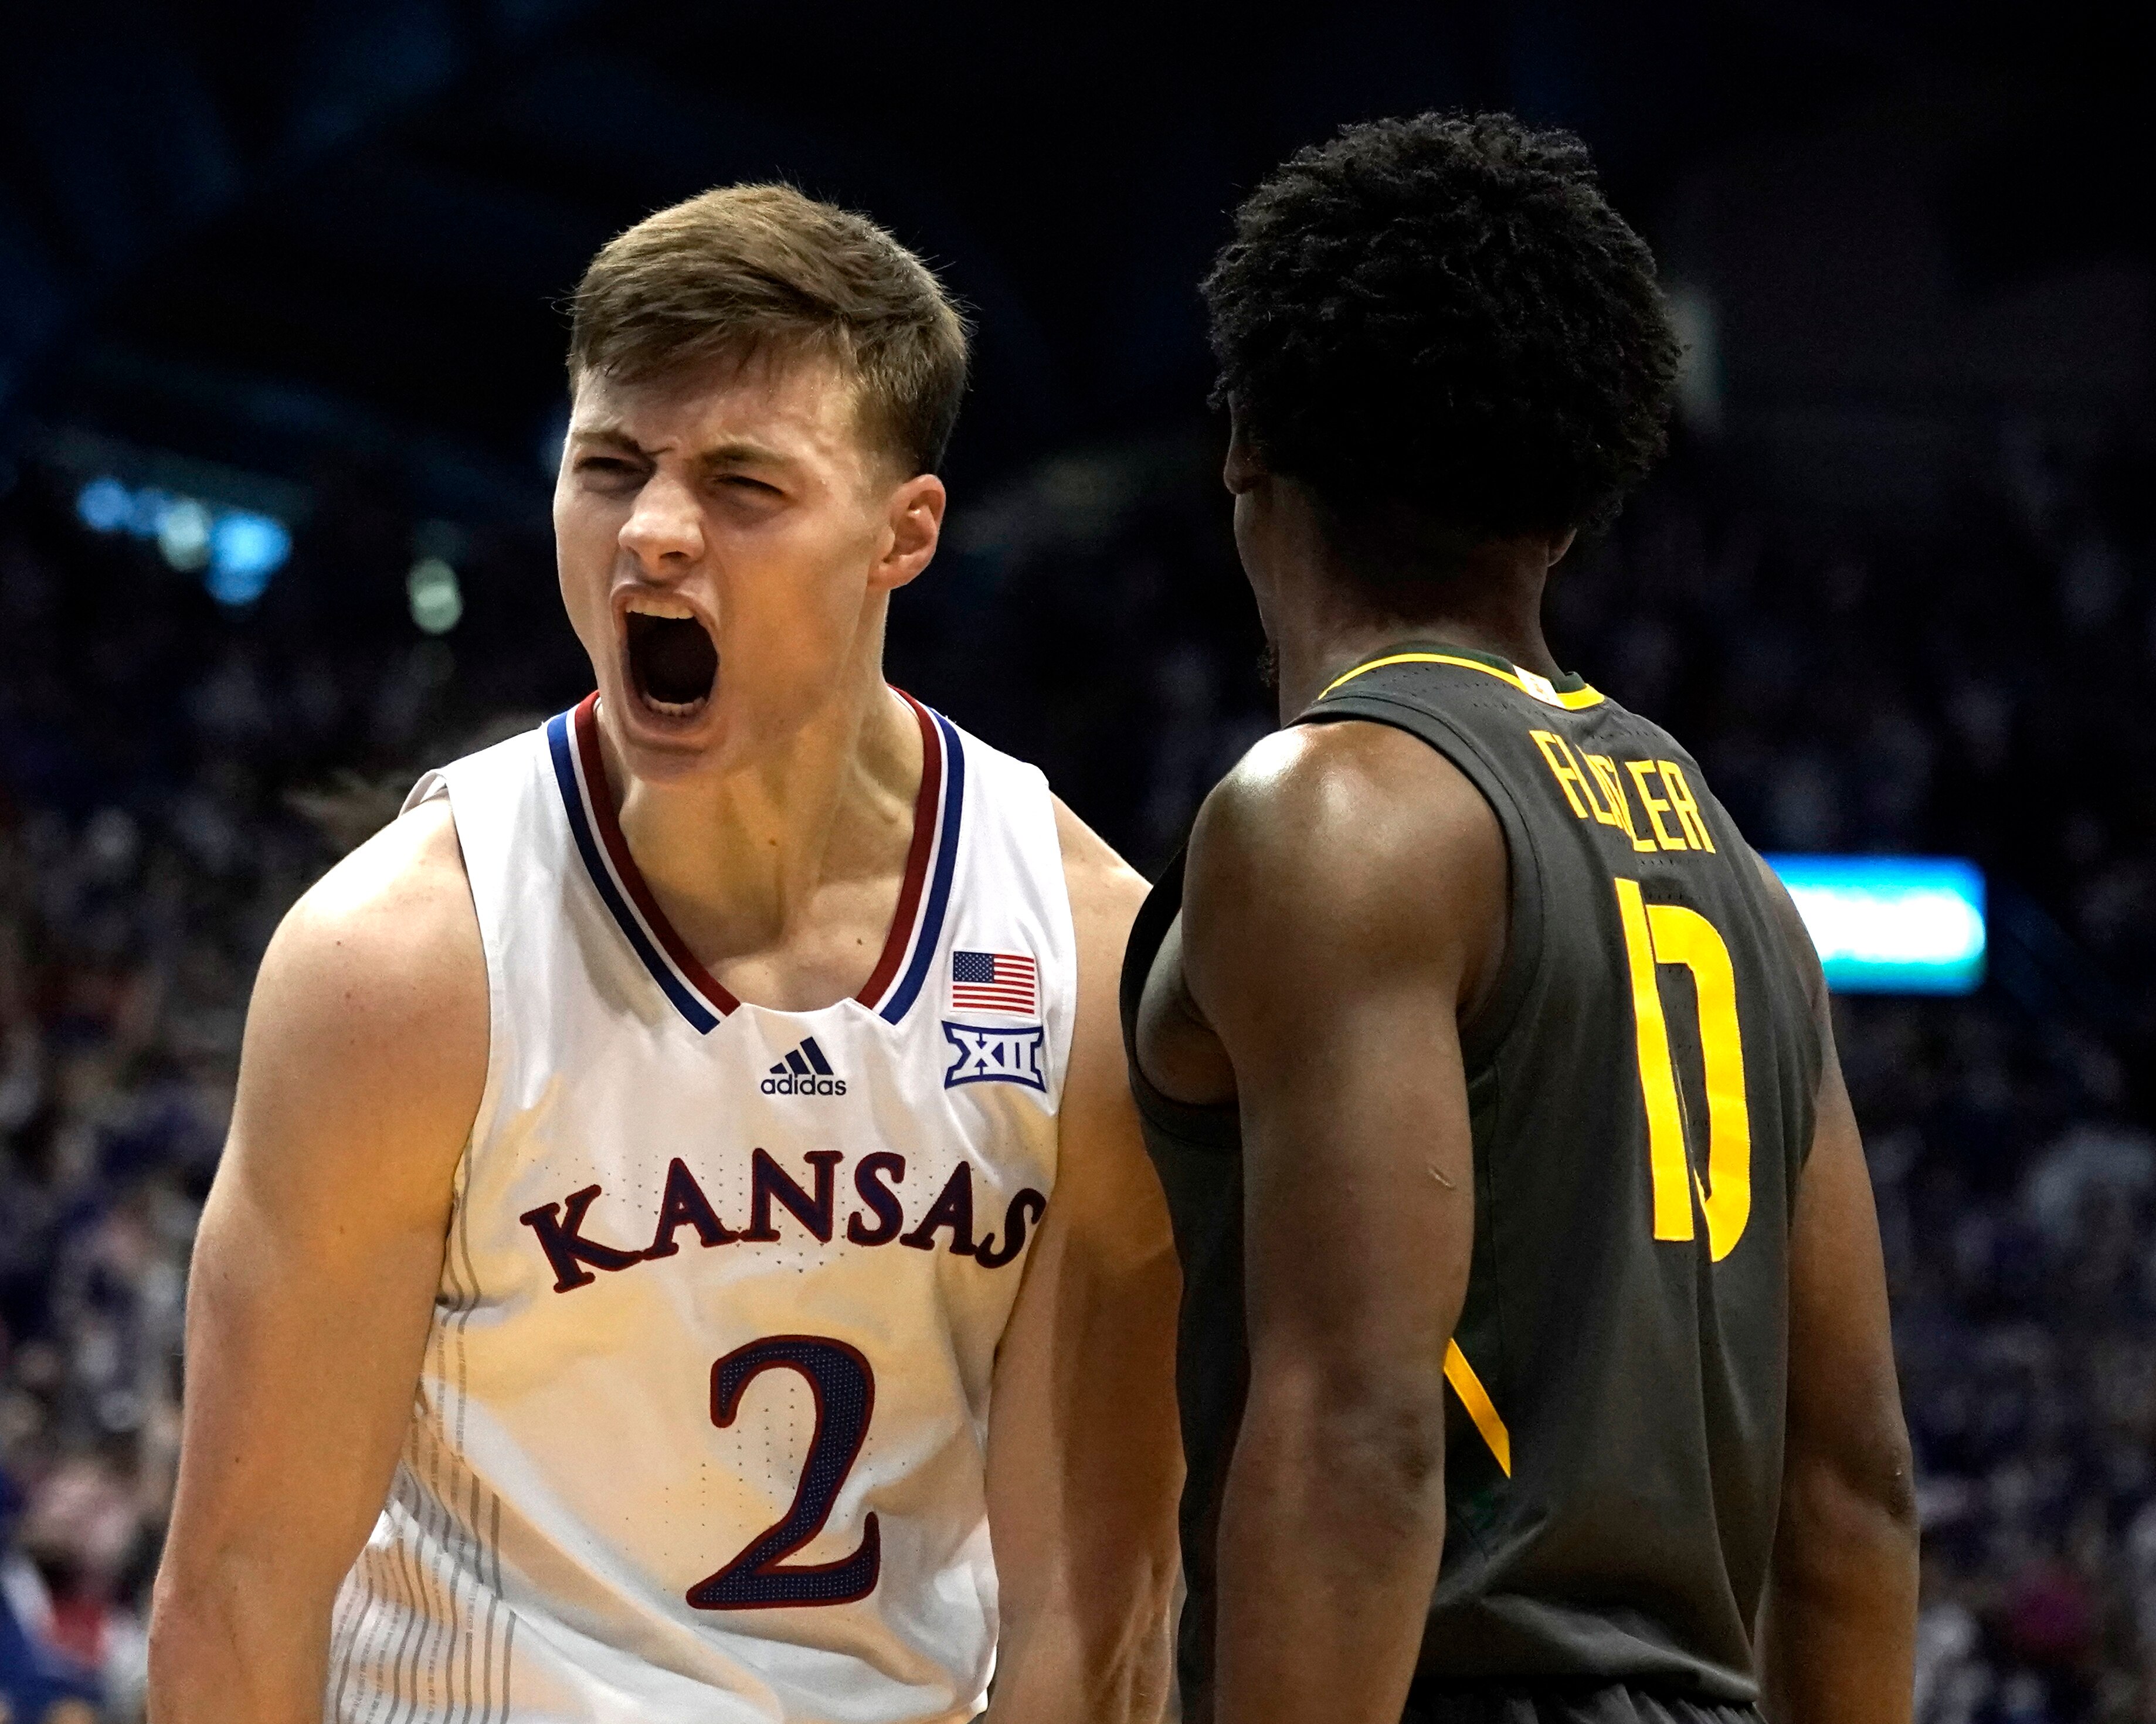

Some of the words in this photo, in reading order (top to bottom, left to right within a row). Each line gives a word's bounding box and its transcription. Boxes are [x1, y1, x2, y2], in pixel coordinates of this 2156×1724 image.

[1529, 730, 1717, 854] FLLER
[760, 1073, 847, 1096] adidas
[945, 1024, 1046, 1089] XII
[520, 1147, 1047, 1294] KANSAS
[685, 1334, 881, 1610] 2
